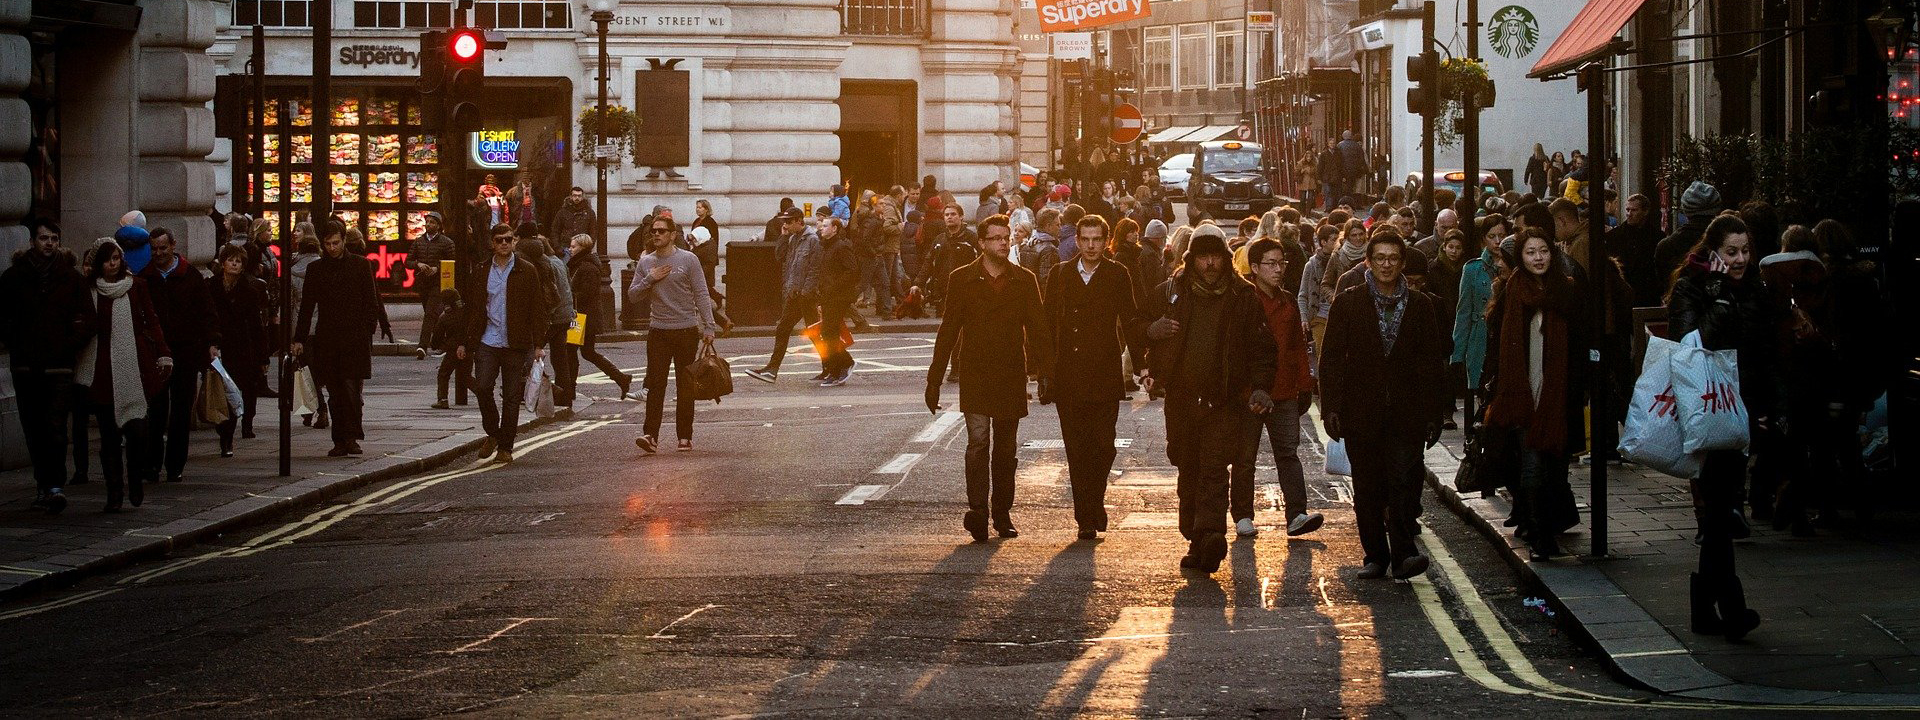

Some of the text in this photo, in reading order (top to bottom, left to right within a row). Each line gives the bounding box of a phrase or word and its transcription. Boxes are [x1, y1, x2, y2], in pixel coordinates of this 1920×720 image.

[658, 16, 701, 26] STREET
[1042, 0, 1142, 25] Superdry
[340, 46, 421, 69] Superdry
[480, 130, 515, 141] T-SHIRT
[1859, 246, 1880, 254] AWAY
[1701, 380, 1738, 415] H&M
